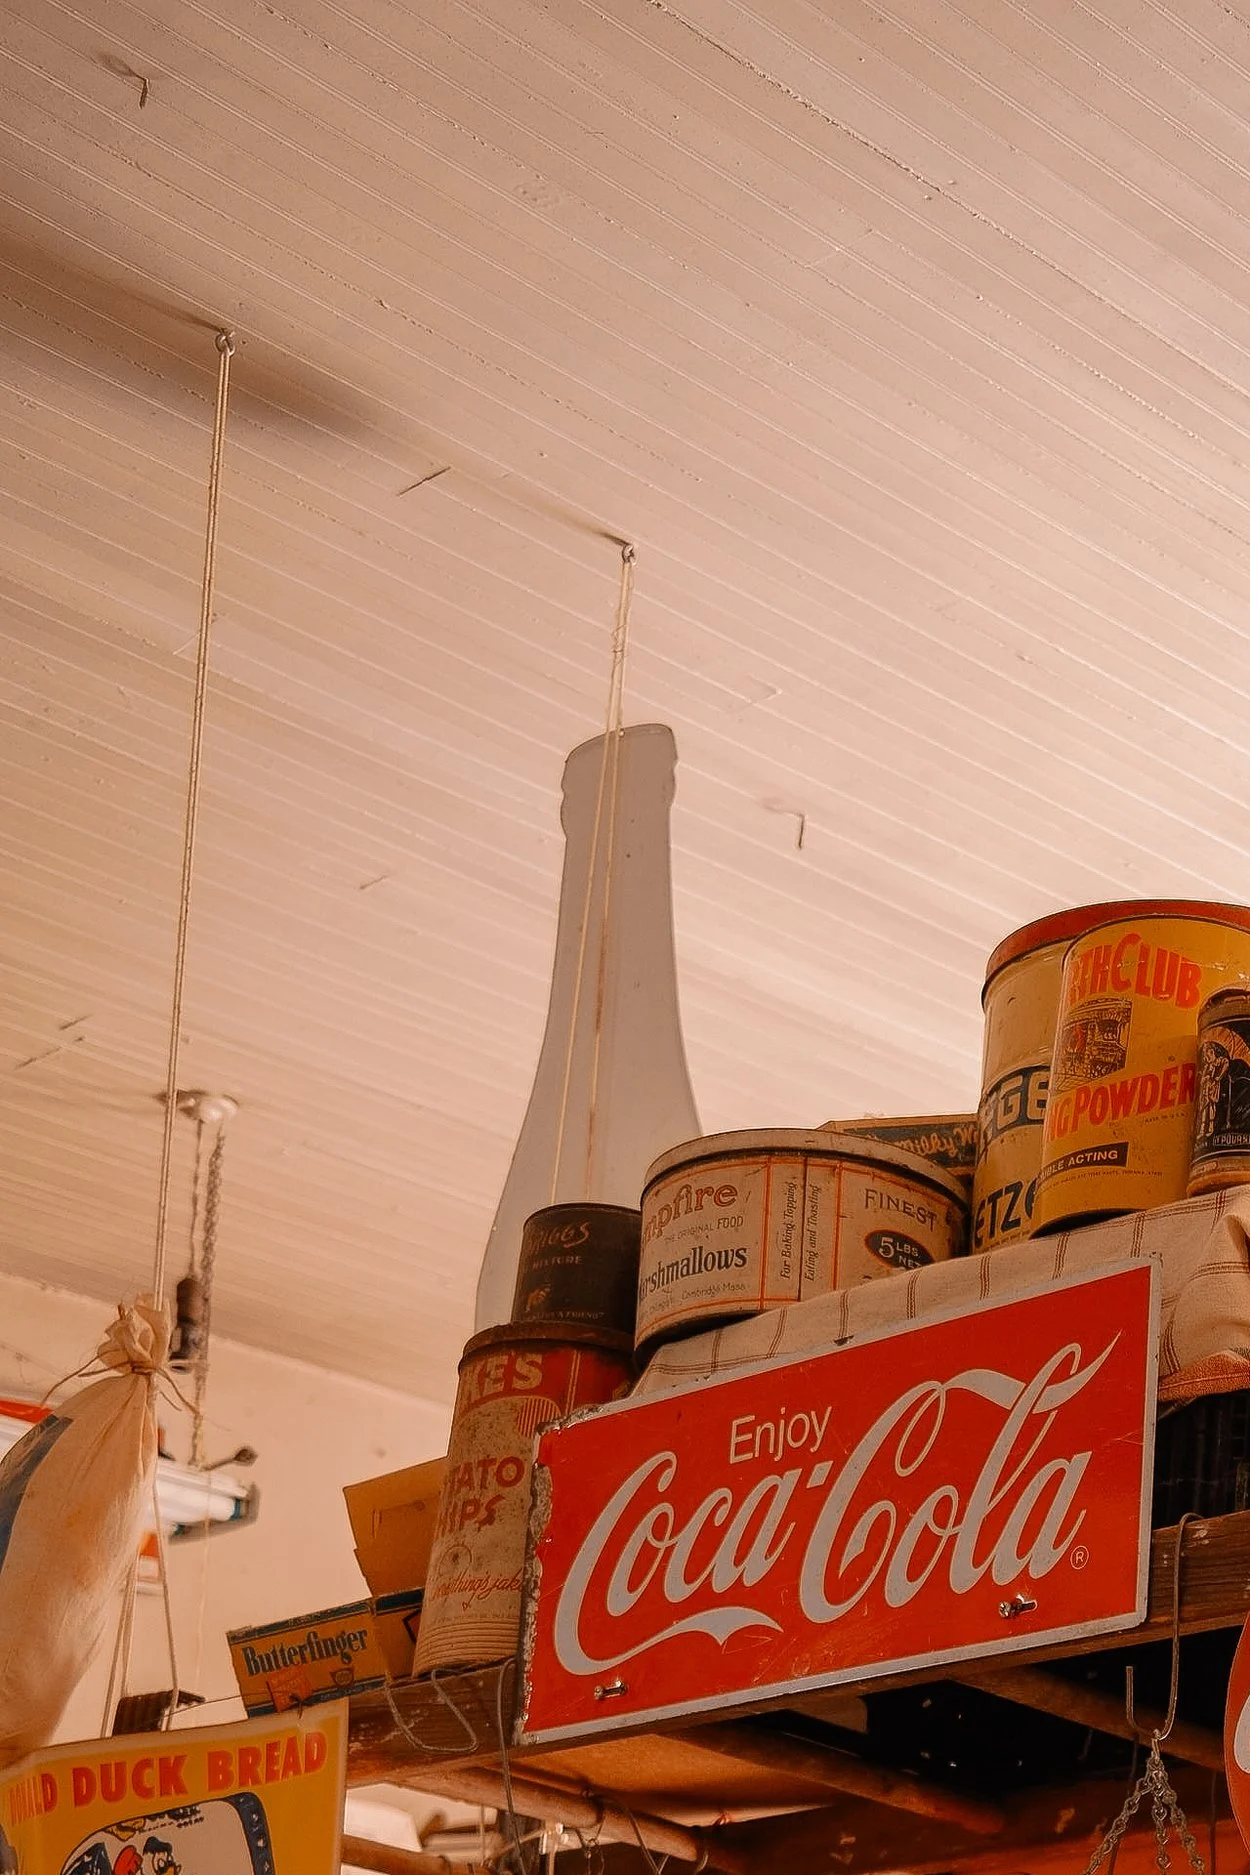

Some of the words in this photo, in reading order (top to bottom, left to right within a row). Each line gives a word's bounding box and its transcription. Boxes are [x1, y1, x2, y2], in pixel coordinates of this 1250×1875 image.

[1068, 1150, 1118, 1167] ACTING
[716, 1216, 744, 1230] FOOD
[807, 1184, 822, 1229] Toasting
[864, 1188, 939, 1233] FINEST
[809, 1230, 817, 1249] and
[879, 1236, 895, 1259] 5
[780, 1260, 791, 1280] For
[729, 1405, 833, 1466] Enjoy
[553, 1331, 1123, 1677] Coca-Cola
[242, 1628, 368, 1677] Butterfinger
[72, 1754, 189, 1809] DUCK
[207, 1731, 328, 1792] BREAD
